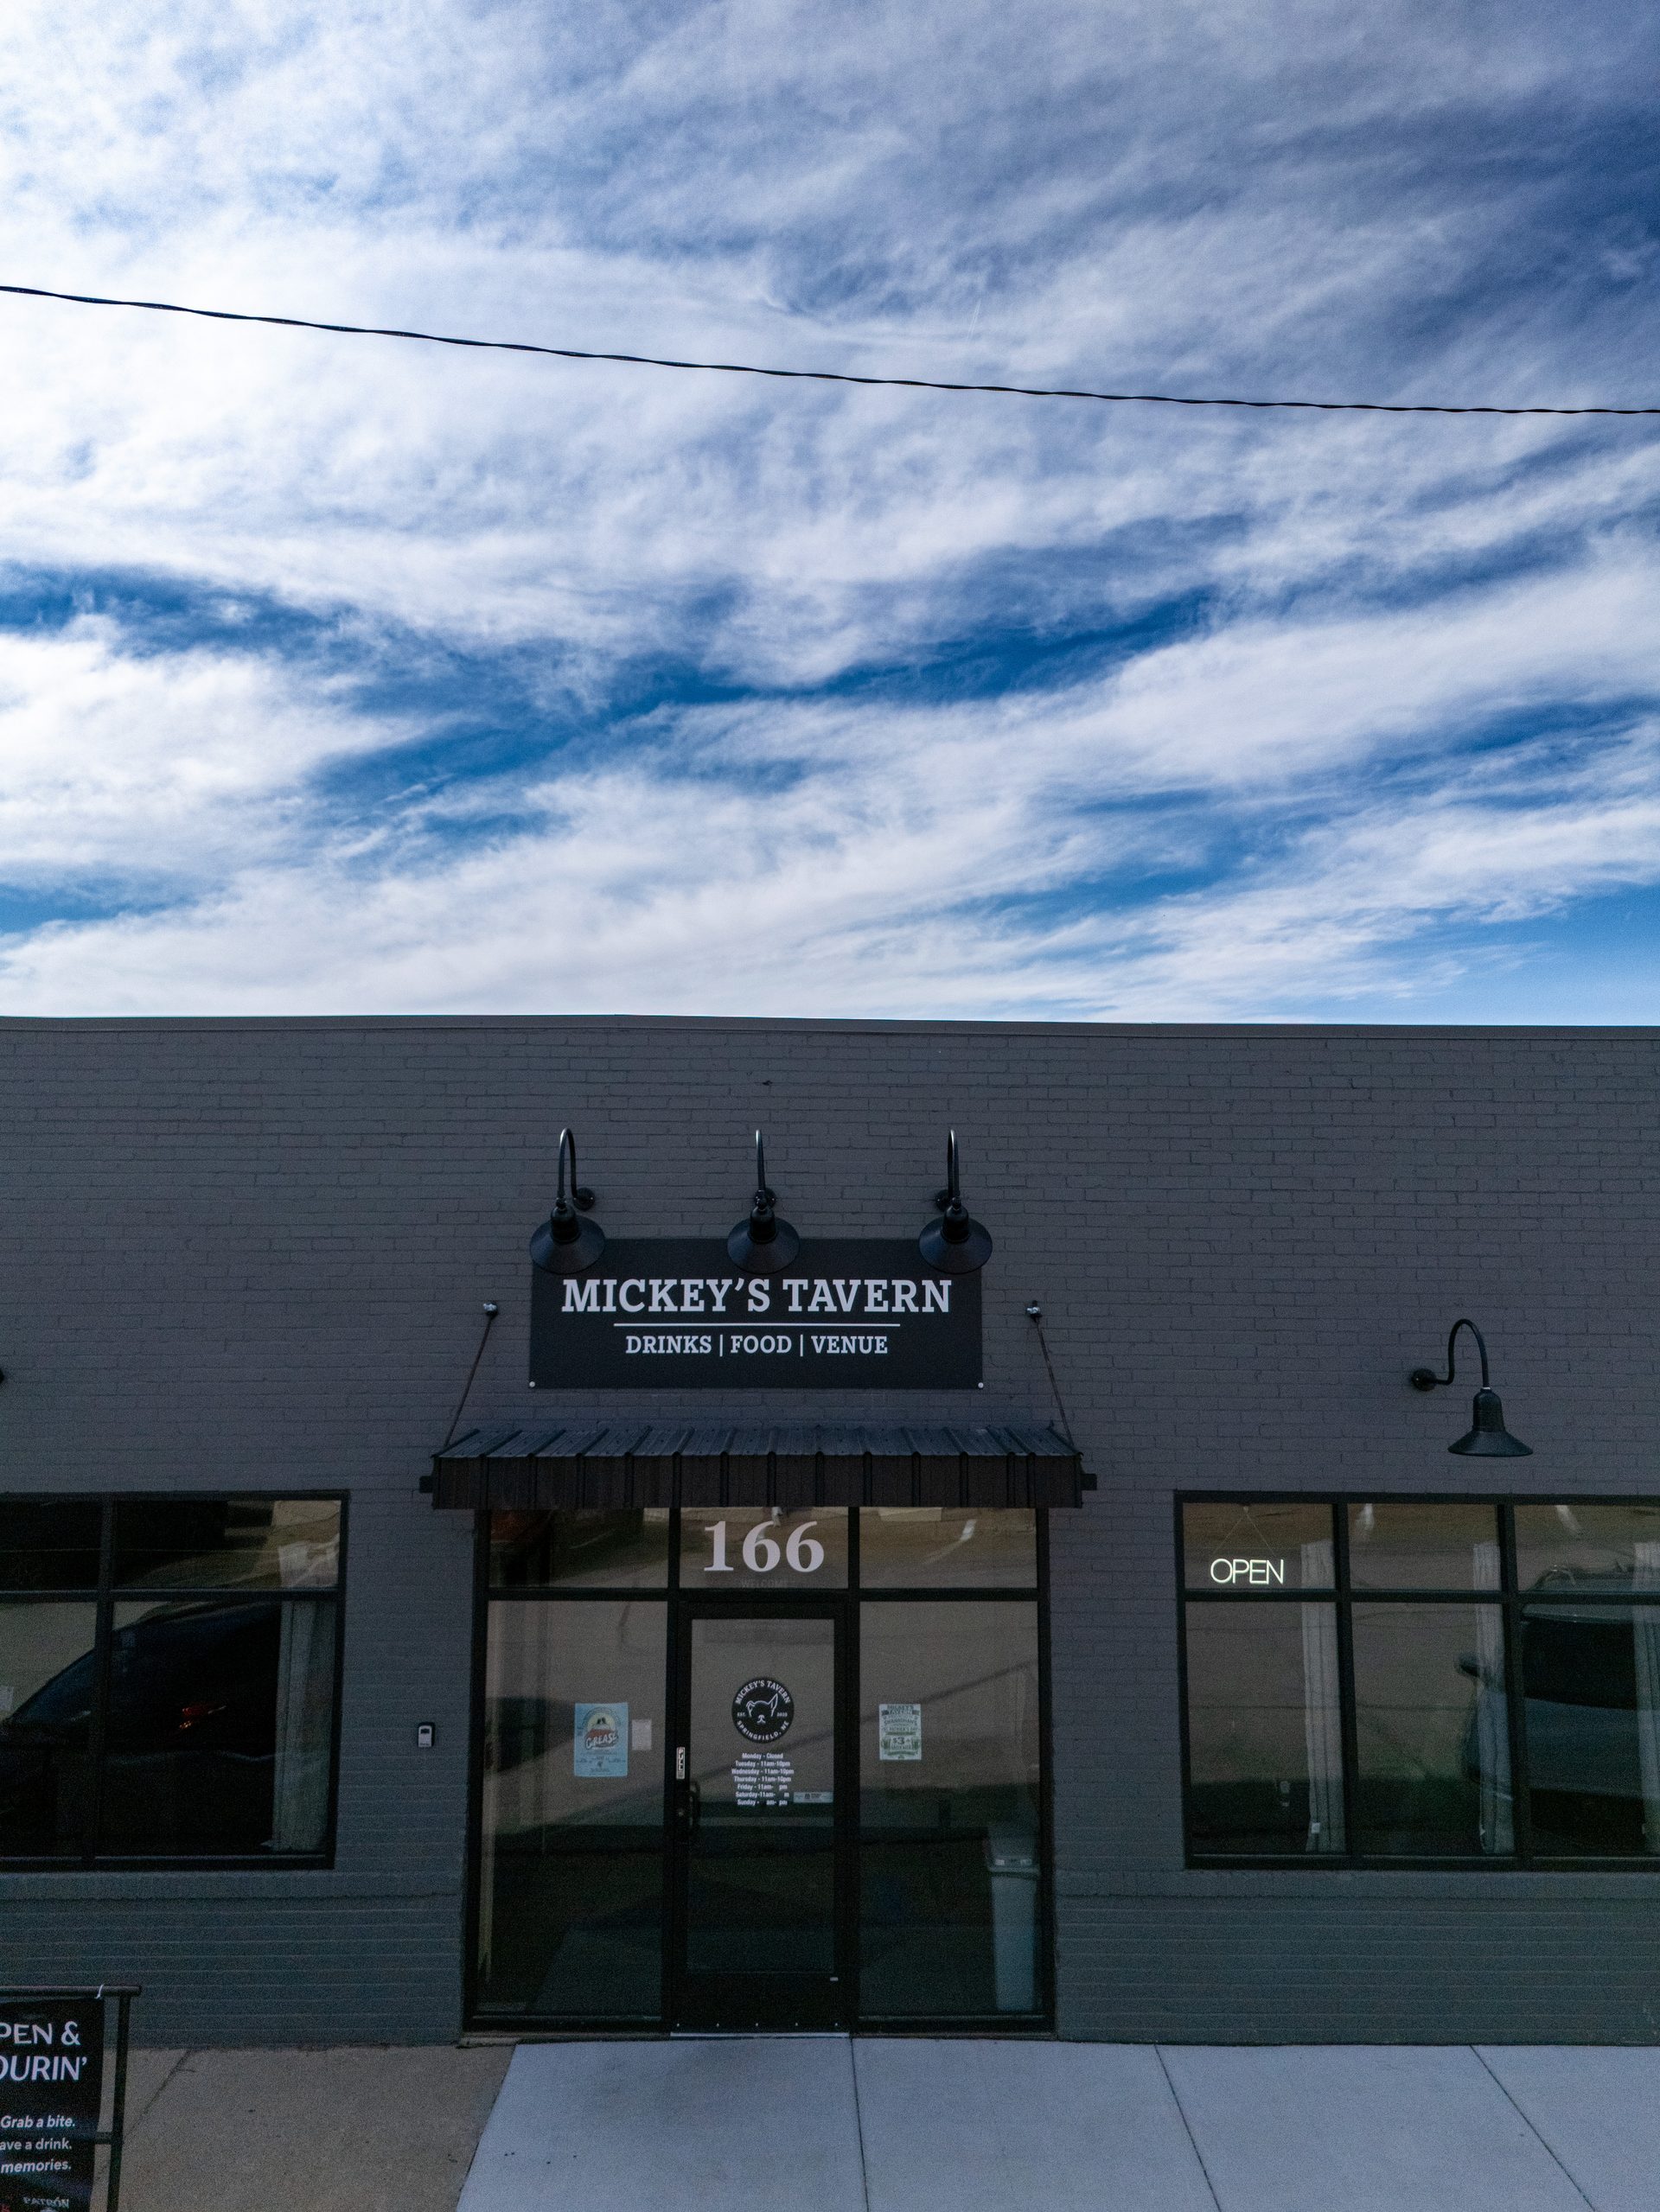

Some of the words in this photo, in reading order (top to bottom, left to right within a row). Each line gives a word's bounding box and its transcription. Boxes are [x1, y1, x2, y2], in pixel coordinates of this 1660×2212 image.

[560, 1278, 770, 1313] MICKEY'S
[782, 1278, 952, 1314] TAVERN
[625, 1335, 712, 1355] DRINKS
[730, 1335, 793, 1355] FOOD
[811, 1335, 888, 1355] VENUE
[704, 1520, 825, 1572] 166
[1210, 1558, 1285, 1584] OPEN
[735, 1680, 765, 1705] MICKEY'S
[766, 1680, 791, 1704] TAVERN
[585, 1732, 617, 1750] GREASE
[737, 1720, 782, 1741] SPRINGFIELD,
[61, 2021, 81, 2046] &
[0, 2115, 34, 2129] Grab
[35, 2118, 44, 2128] a
[46, 2114, 76, 2127] bite.
[0, 2141, 22, 2151] ave
[25, 2141, 33, 2150] a
[35, 2137, 73, 2150] drink.
[0, 2158, 72, 2174] memories.
